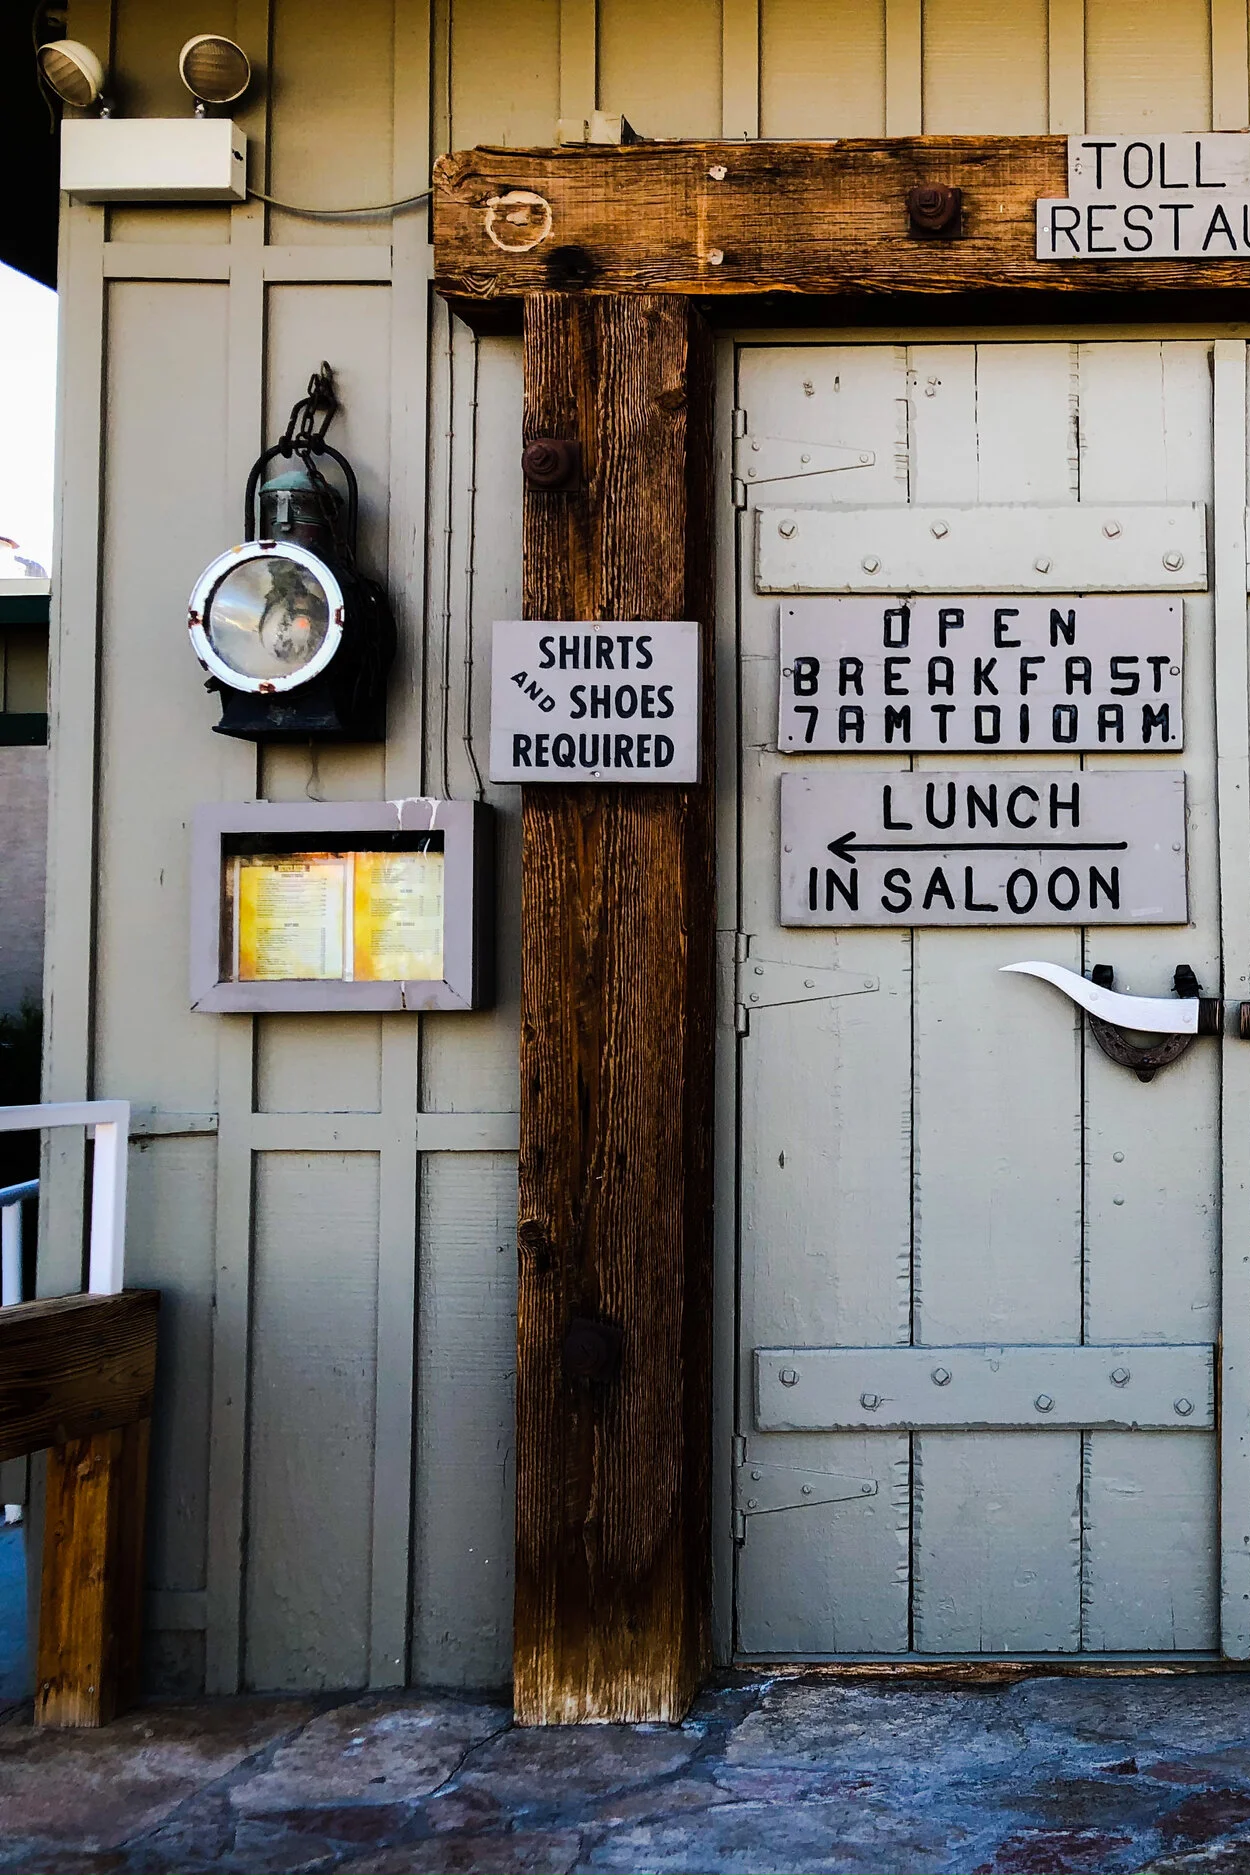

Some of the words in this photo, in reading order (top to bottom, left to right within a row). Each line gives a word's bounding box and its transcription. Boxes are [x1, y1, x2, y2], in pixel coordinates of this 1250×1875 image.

[1081, 141, 1227, 190] TOLL
[884, 608, 1076, 648] OPEN
[538, 635, 653, 670] SHIRTS
[510, 671, 556, 713] AND
[569, 684, 675, 720] SHOES
[793, 656, 1171, 696] BREAKFAST
[512, 732, 675, 769] REQUIRED
[882, 781, 1080, 831] LUNCH
[808, 866, 859, 912] IN
[880, 865, 1120, 915] SALOON
